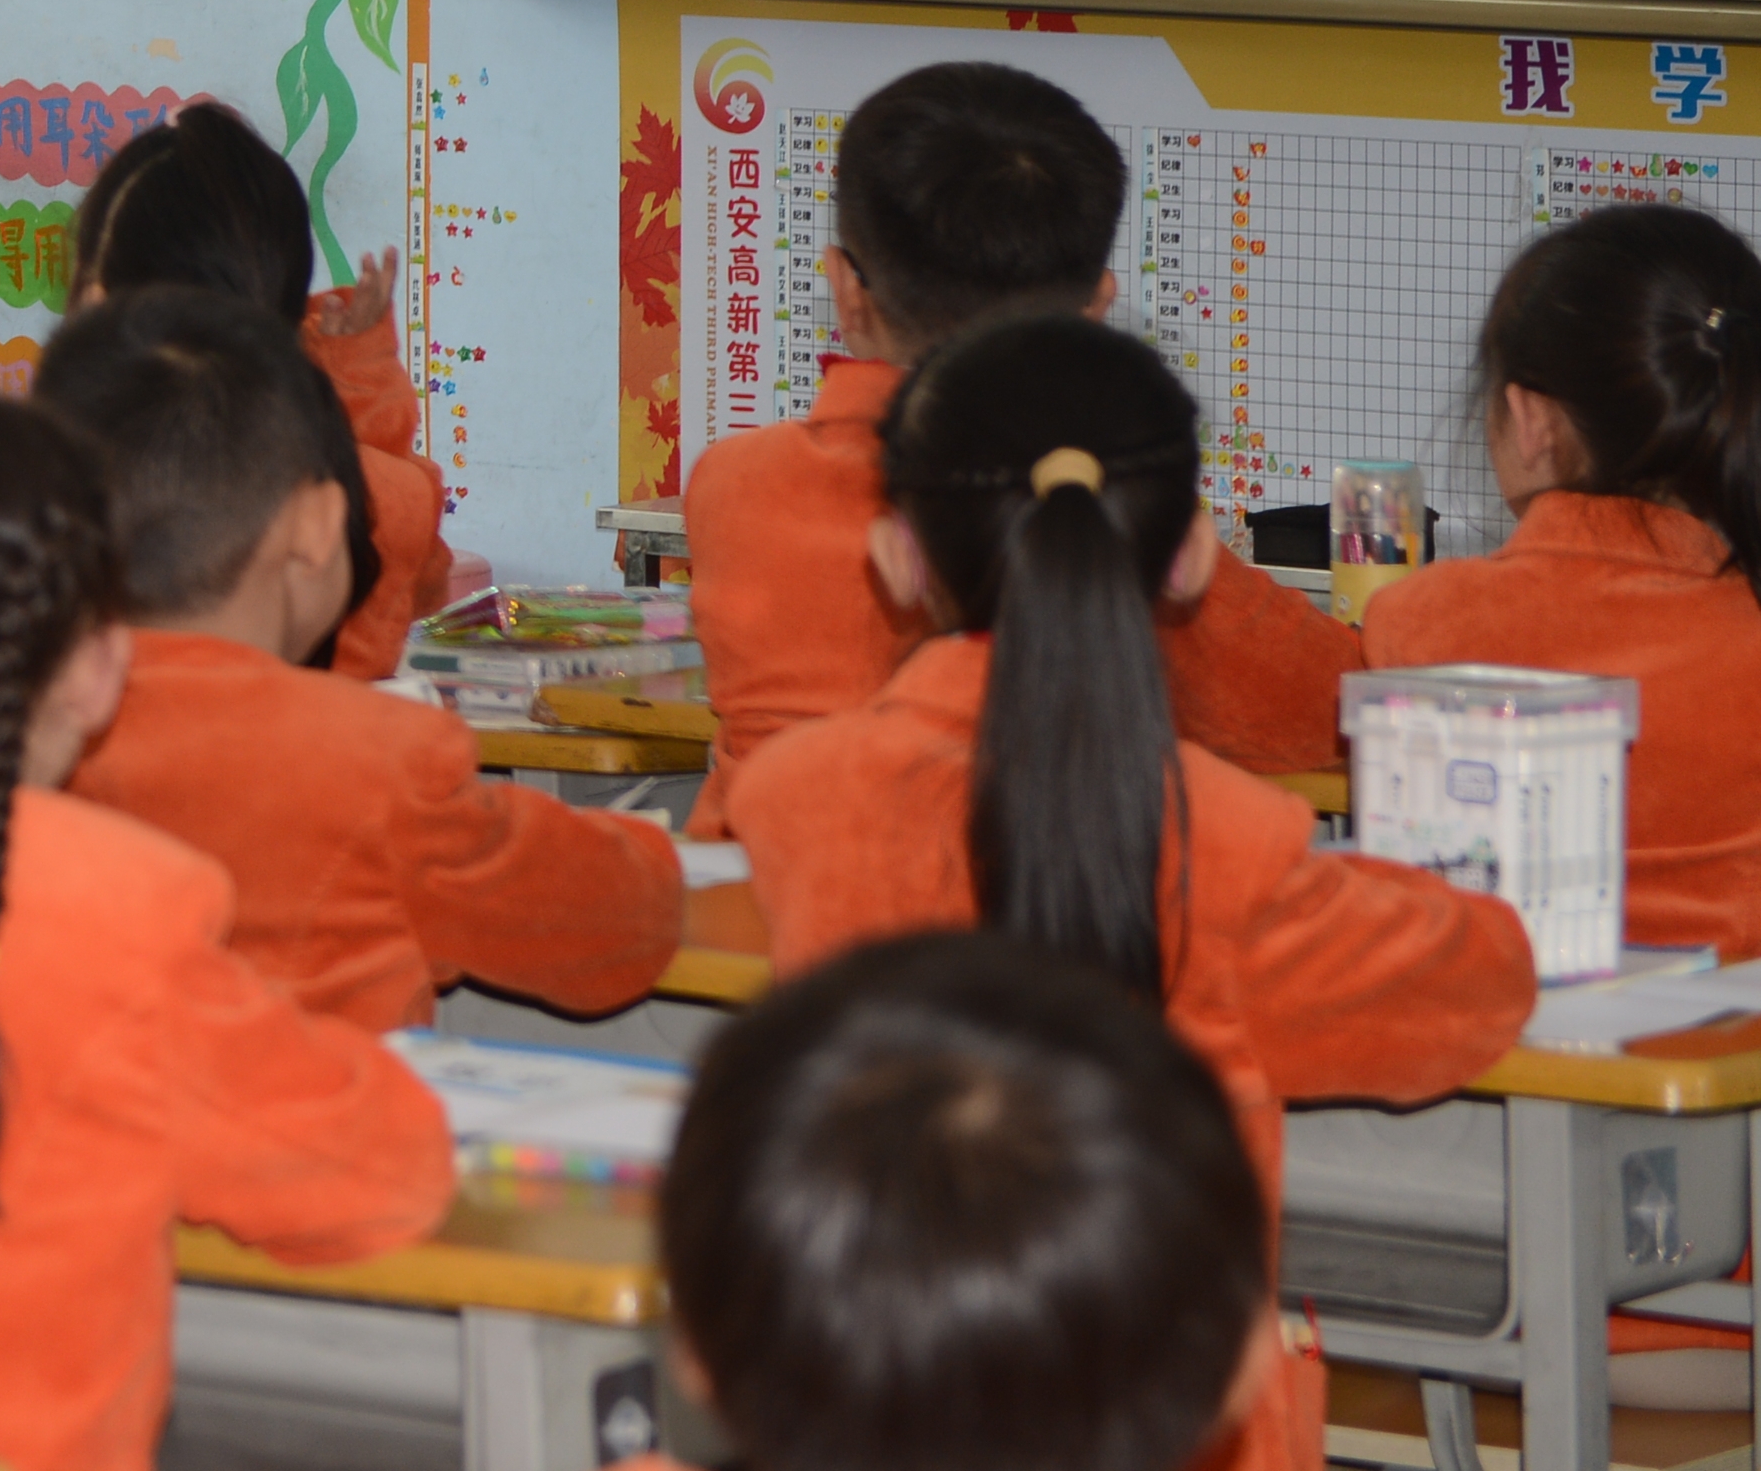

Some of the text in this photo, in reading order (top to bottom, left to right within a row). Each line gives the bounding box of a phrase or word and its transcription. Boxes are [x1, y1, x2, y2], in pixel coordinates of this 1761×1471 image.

[794, 117, 813, 128] 学习
[793, 139, 812, 150] 纪律
[1161, 135, 1181, 147] 学习
[1161, 159, 1181, 171] 纪律
[1553, 156, 1574, 168] 学习
[707, 146, 717, 197] XI'AN
[793, 163, 812, 174] 卫生
[793, 187, 812, 197] 学习
[1161, 183, 1180, 196] 卫生
[1553, 180, 1574, 192] 纪律
[793, 210, 812, 221] 纪律
[1161, 208, 1181, 220] 学习
[1553, 206, 1575, 219] 卫生
[793, 234, 812, 245] 卫生
[1160, 232, 1180, 244] 纪律
[707, 202, 717, 300] HIGH-TECH
[793, 258, 812, 269] 学习
[1160, 257, 1180, 268] 卫生
[727, 149, 762, 429] 西安高新第三
[793, 281, 811, 292] 纪律
[1160, 281, 1180, 293] 学习
[792, 304, 811, 316] 卫生
[1160, 305, 1180, 317] 纪律
[707, 305, 717, 362] THIRD
[793, 328, 812, 340] 学习
[1160, 330, 1179, 342] 卫生
[792, 352, 811, 363] 纪律
[792, 375, 811, 386] 卫生
[792, 399, 811, 411] 学习
